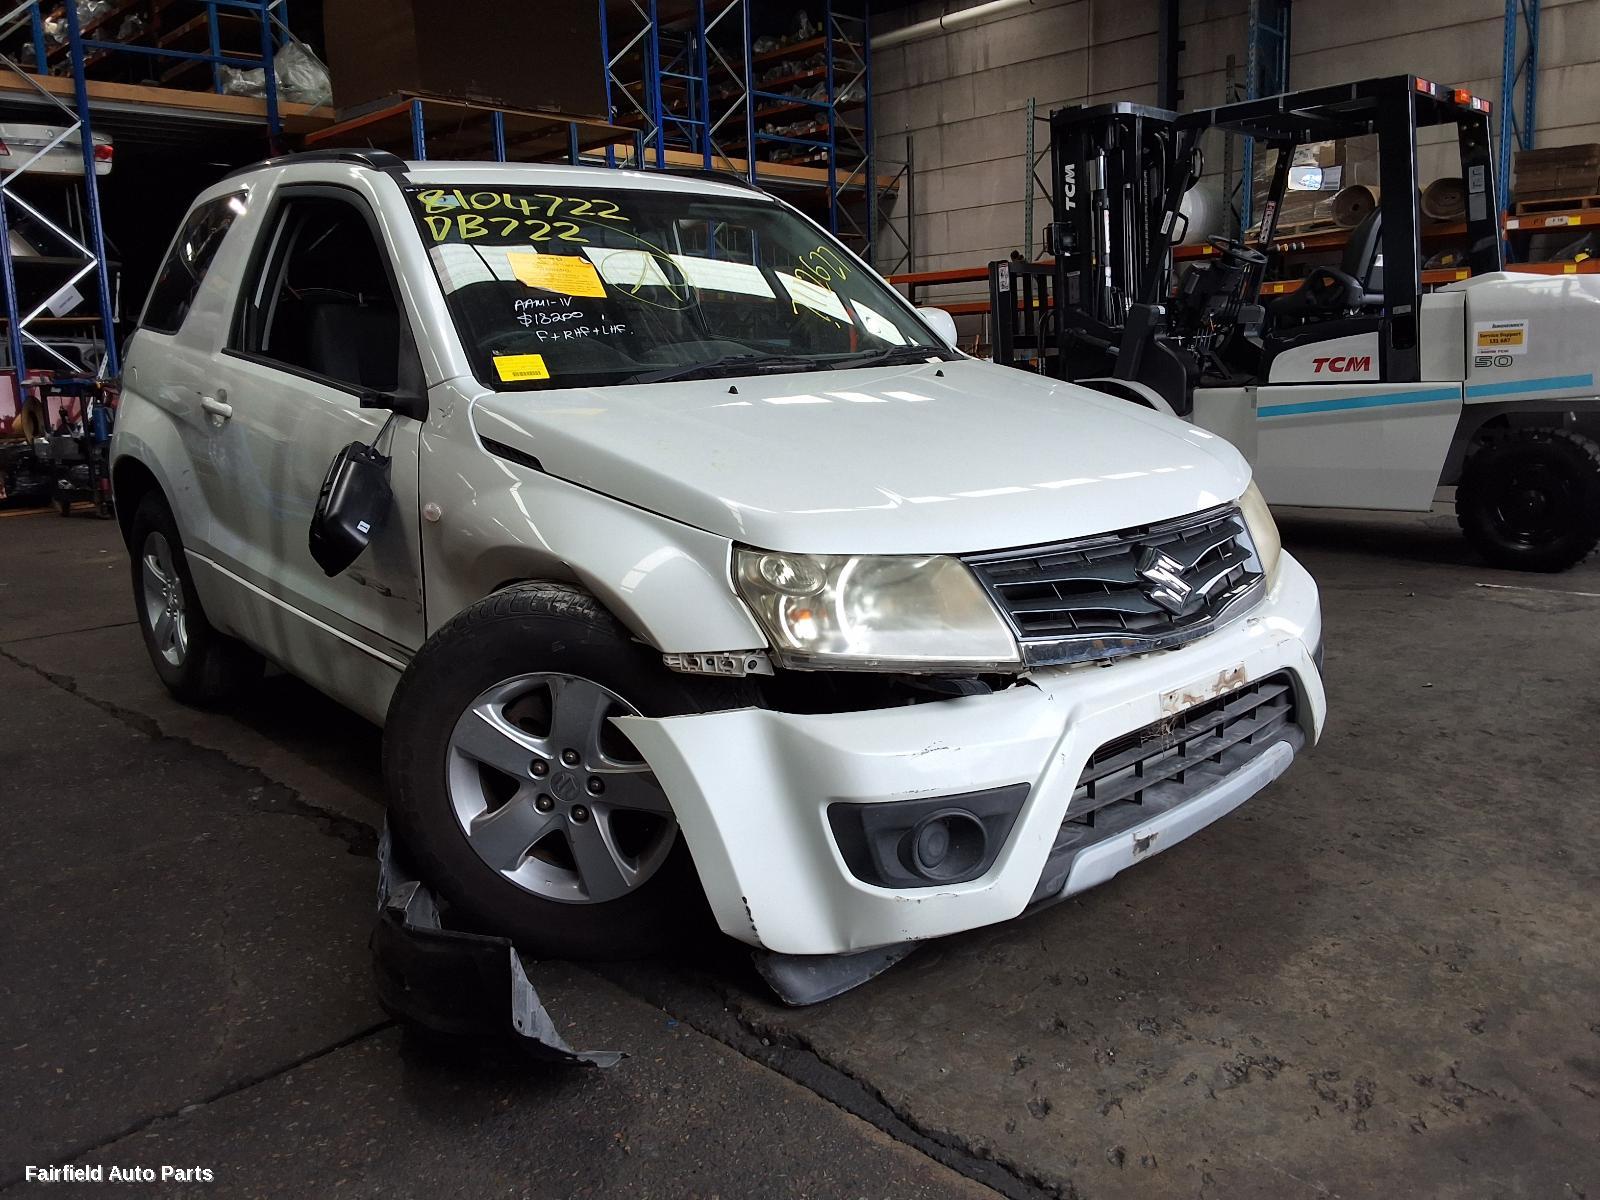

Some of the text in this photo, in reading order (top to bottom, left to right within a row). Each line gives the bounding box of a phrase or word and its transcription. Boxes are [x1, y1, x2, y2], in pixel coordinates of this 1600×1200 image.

[1065, 164, 1075, 210] TCM
[417, 189, 630, 221] 8104722
[424, 214, 590, 243] DB722
[1312, 356, 1371, 373] TCM
[1474, 355, 1513, 368] 50
